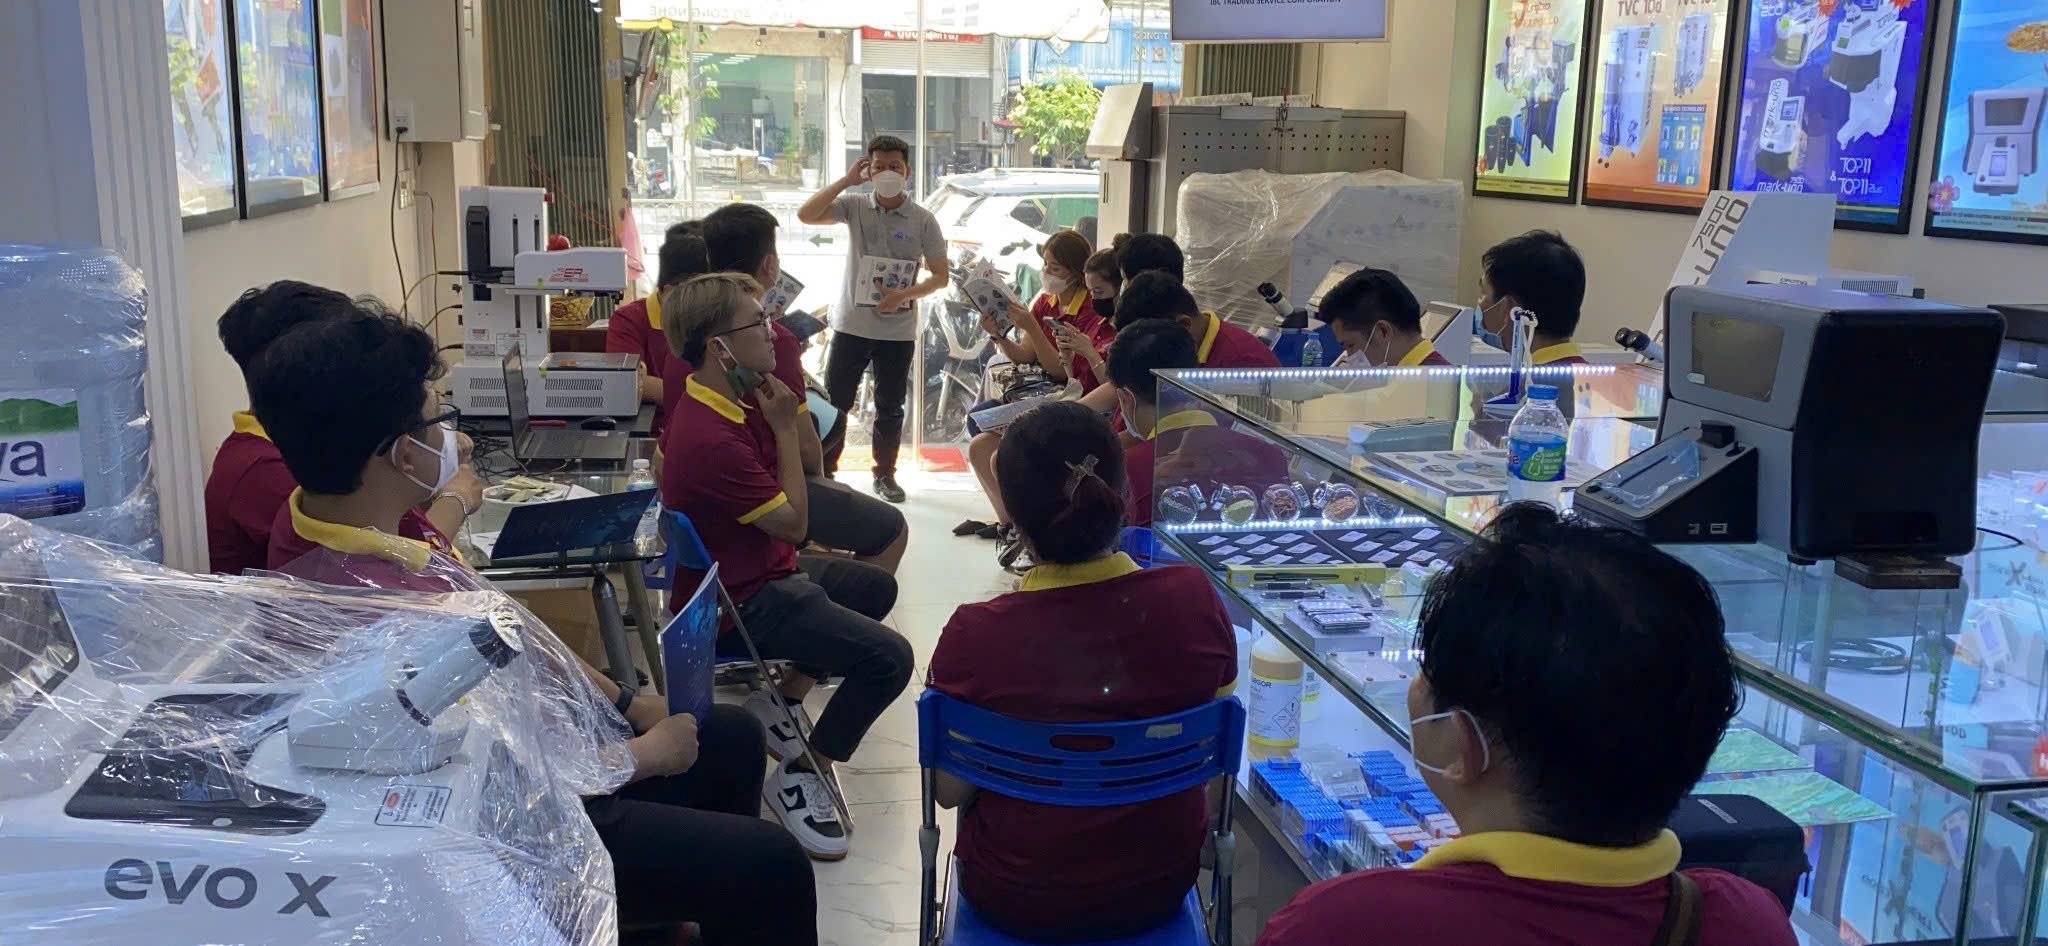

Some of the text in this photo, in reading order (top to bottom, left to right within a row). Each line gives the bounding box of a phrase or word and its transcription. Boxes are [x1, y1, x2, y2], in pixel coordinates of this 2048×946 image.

[1618, 0, 1639, 16] TVC
[1692, 195, 1731, 250] 7500
[104, 858, 258, 910] evo
